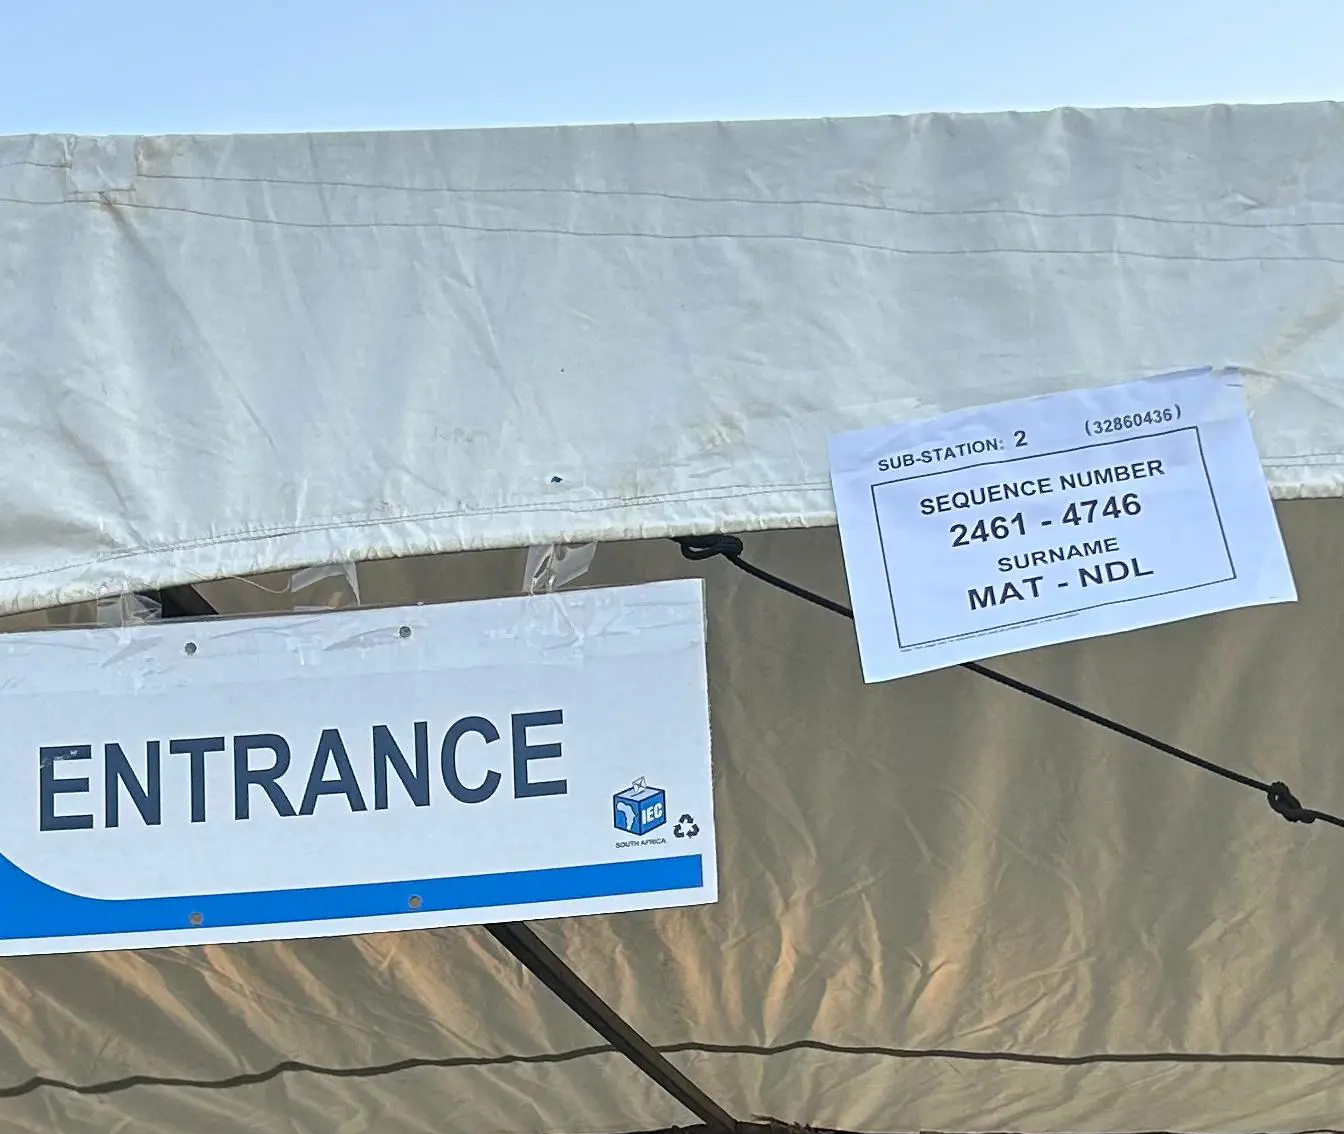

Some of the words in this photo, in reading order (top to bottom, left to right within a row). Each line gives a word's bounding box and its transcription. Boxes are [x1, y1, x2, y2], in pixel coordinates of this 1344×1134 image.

[877, 437, 1005, 472] SUB-STATION:
[1013, 430, 1028, 448] 2
[1084, 403, 1182, 437] (32860436)
[920, 477, 1054, 516] SEQUENCE
[1059, 459, 1166, 491] NUMBER
[949, 512, 1027, 548] 2461
[1061, 493, 1142, 526] 4746
[997, 537, 1121, 573] SURNAME
[967, 575, 1044, 611] MAT
[1077, 557, 1155, 588] NDL
[38, 708, 569, 832] ENTRANCE
[641, 802, 663, 825] IEC
[615, 840, 640, 849] SOUTH
[640, 837, 667, 846] AFRICA
